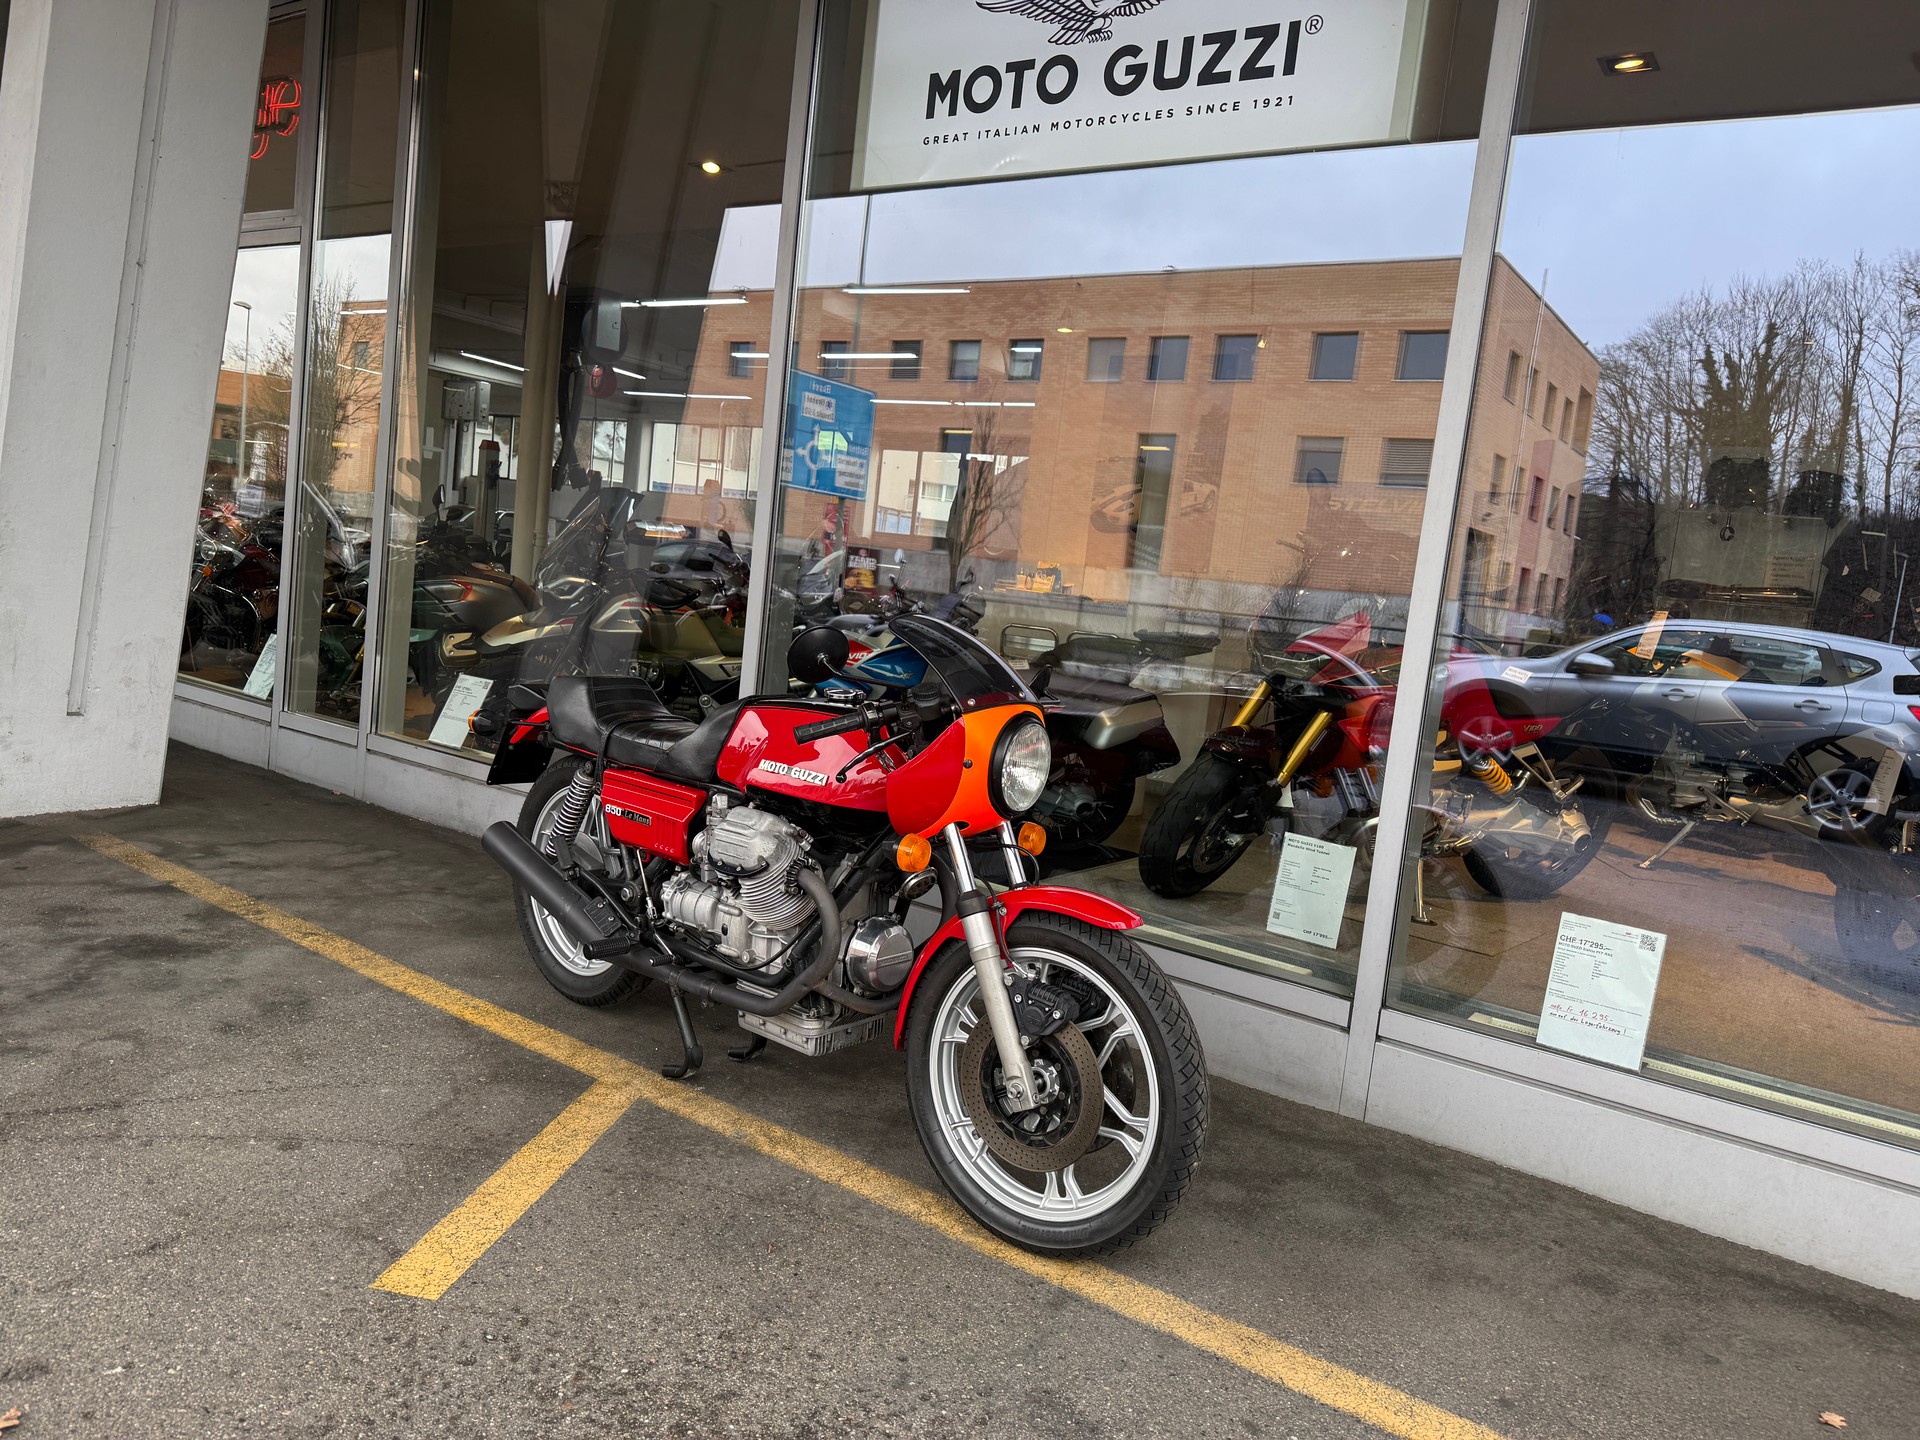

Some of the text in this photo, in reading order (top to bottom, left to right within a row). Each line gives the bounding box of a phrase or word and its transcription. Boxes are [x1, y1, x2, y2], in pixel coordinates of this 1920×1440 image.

[925, 54, 1079, 119] MOTO
[1103, 20, 1302, 96] GUZZI
[923, 95, 1294, 145] GREAT ITALIAN MOTORCYCLES SINCE 1921
[758, 759, 829, 786] MOTO GUZZI
[605, 804, 650, 825] 850 Le Mans
[1560, 934, 1577, 943] CHF
